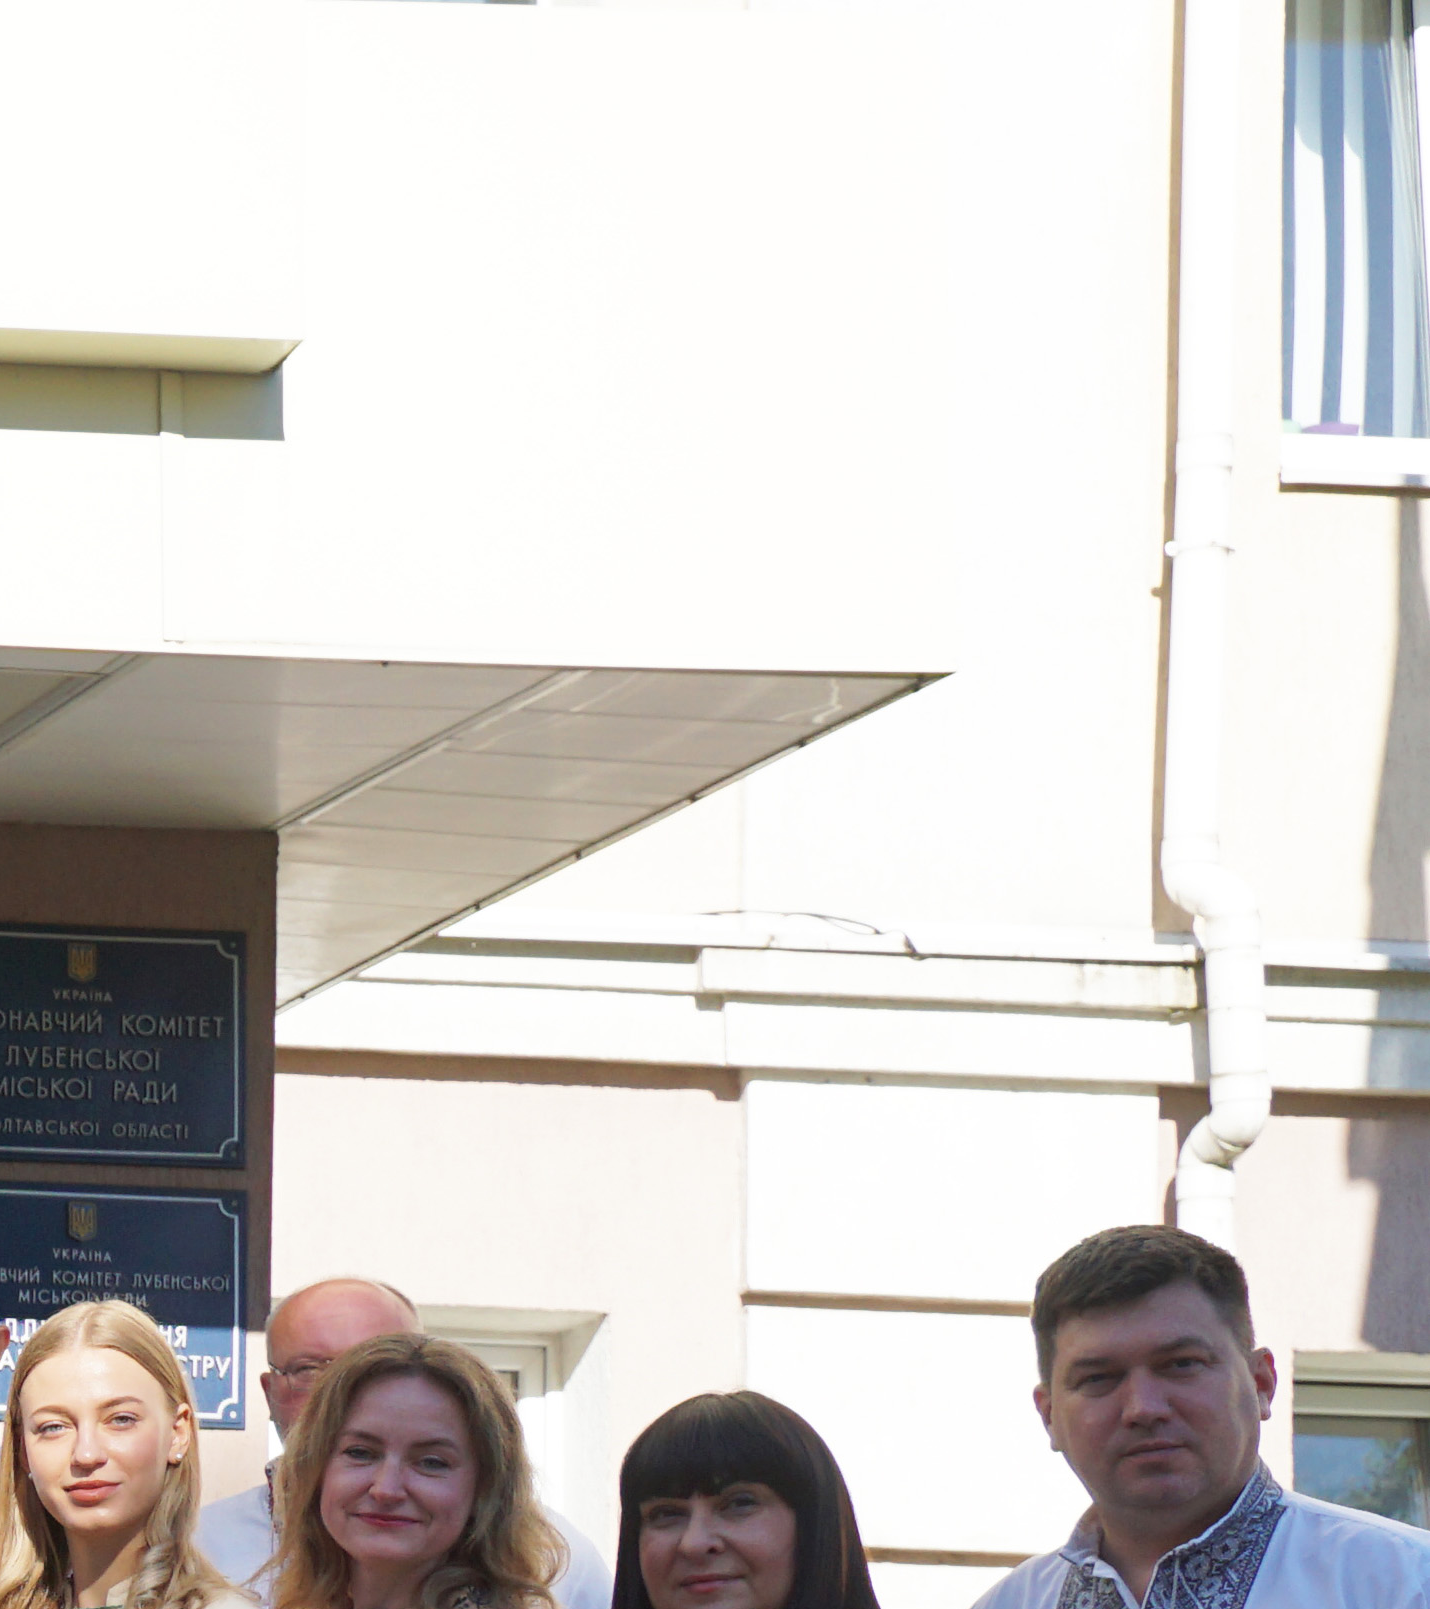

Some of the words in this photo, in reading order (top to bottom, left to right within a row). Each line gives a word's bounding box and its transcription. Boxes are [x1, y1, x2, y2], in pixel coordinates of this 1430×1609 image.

[121, 1014, 225, 1038] КОМІТЕТ
[5, 1045, 161, 1072] ЛУБЕНСЬКОЇ
[113, 1080, 178, 1104] РАДИ
[112, 1123, 189, 1140] ОБЛАСТІ
[52, 1270, 122, 1288] КОМІТЕТ
[132, 1272, 231, 1292] ЛУБЕНСЬКОЇ
